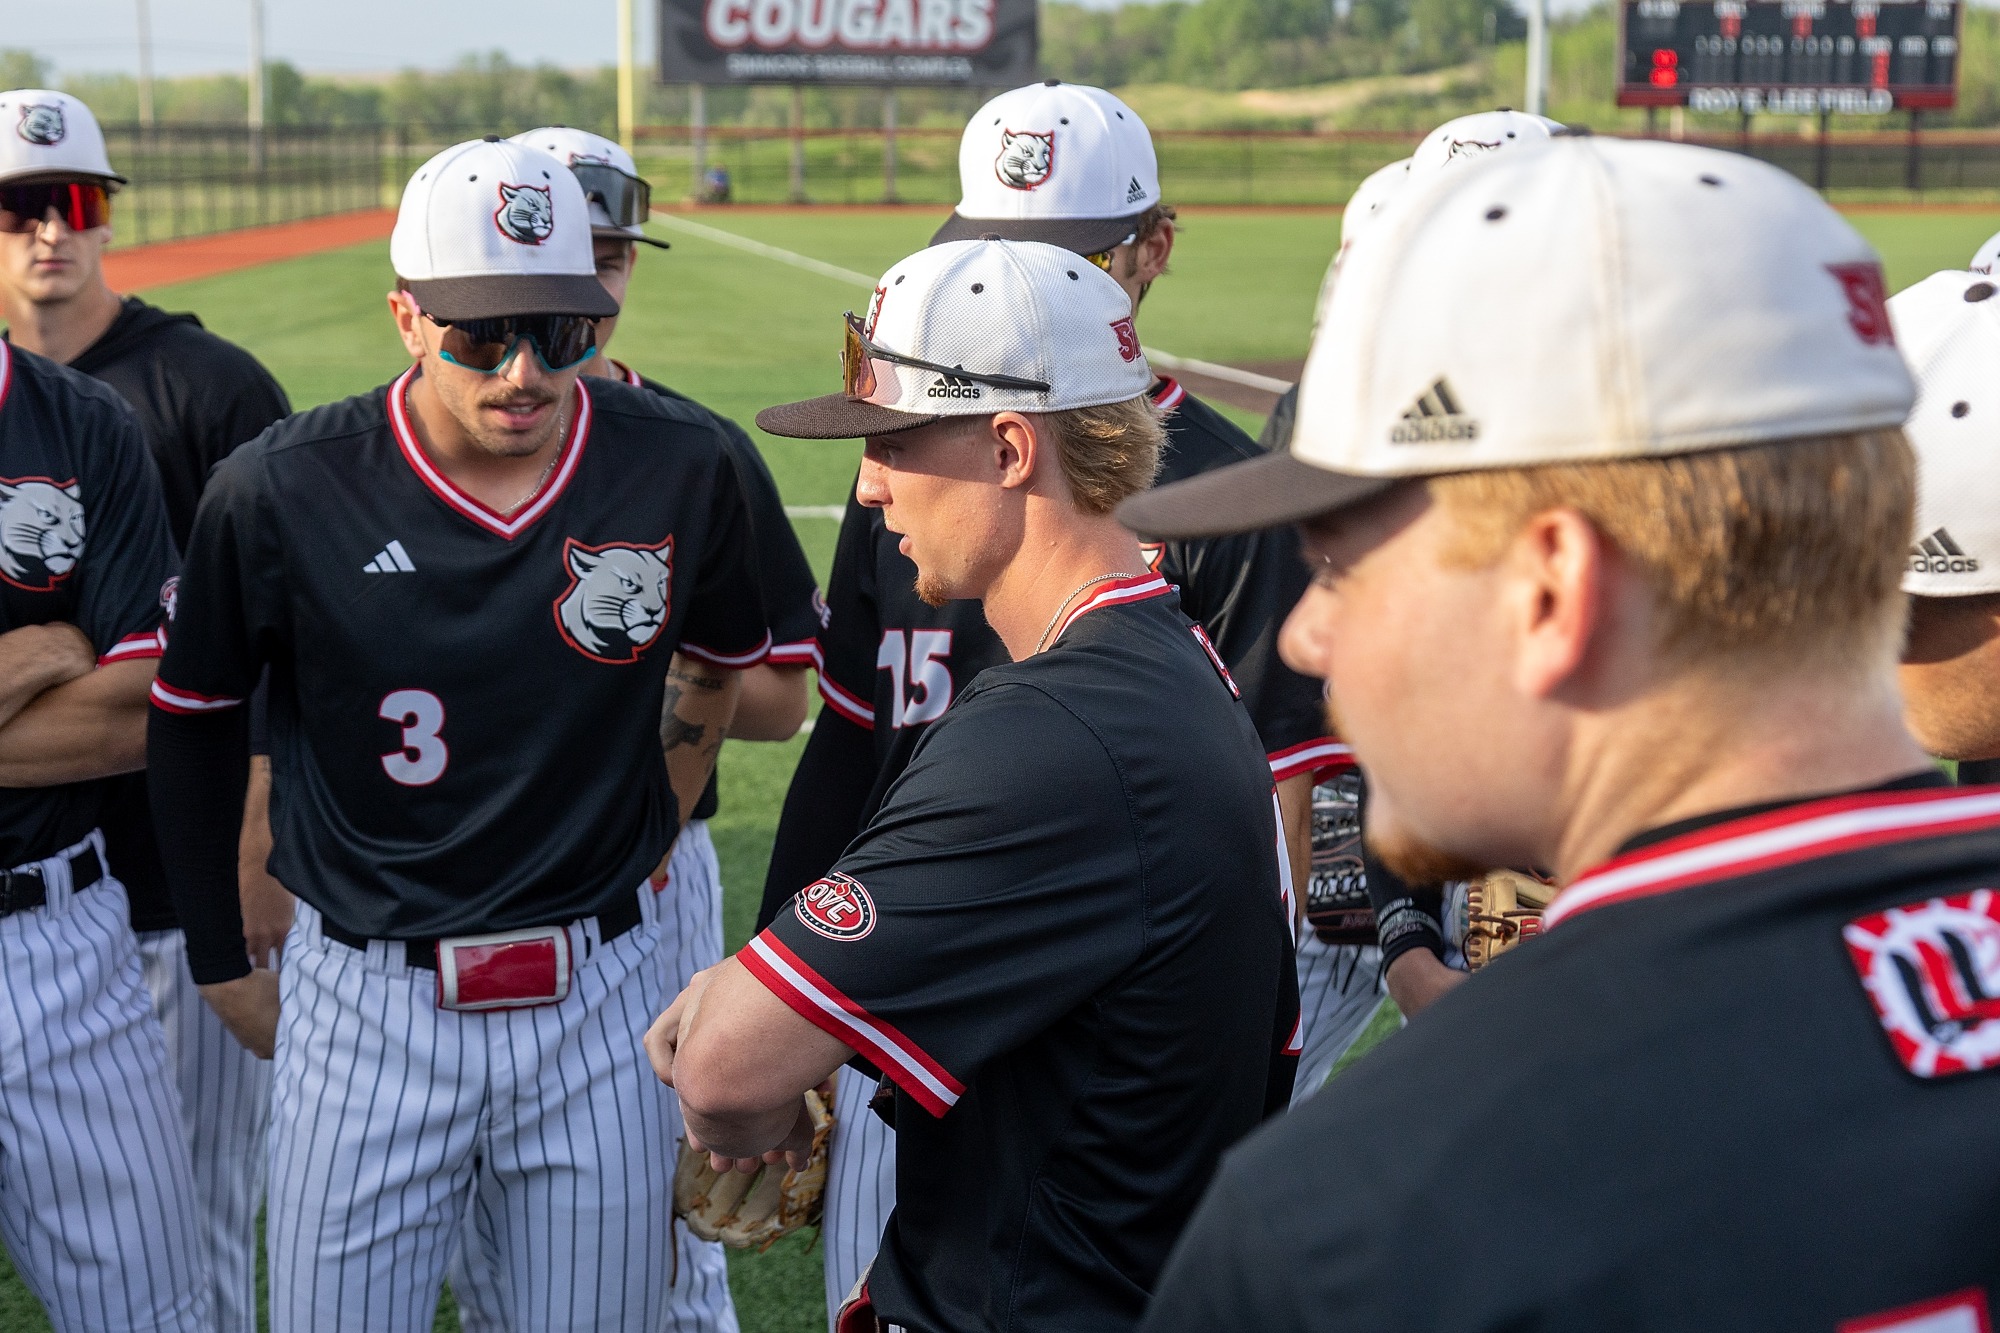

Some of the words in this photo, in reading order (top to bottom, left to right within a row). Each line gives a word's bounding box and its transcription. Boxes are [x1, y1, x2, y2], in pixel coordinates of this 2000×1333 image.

[703, 0, 996, 52] COUGARS
[1689, 86, 1738, 115] ROY
[1818, 87, 1894, 116] FIELD
[927, 384, 980, 399] adidas
[1389, 420, 1477, 444] adidas
[877, 628, 953, 729] 15
[378, 687, 449, 787] 3
[807, 883, 858, 924] OVC
